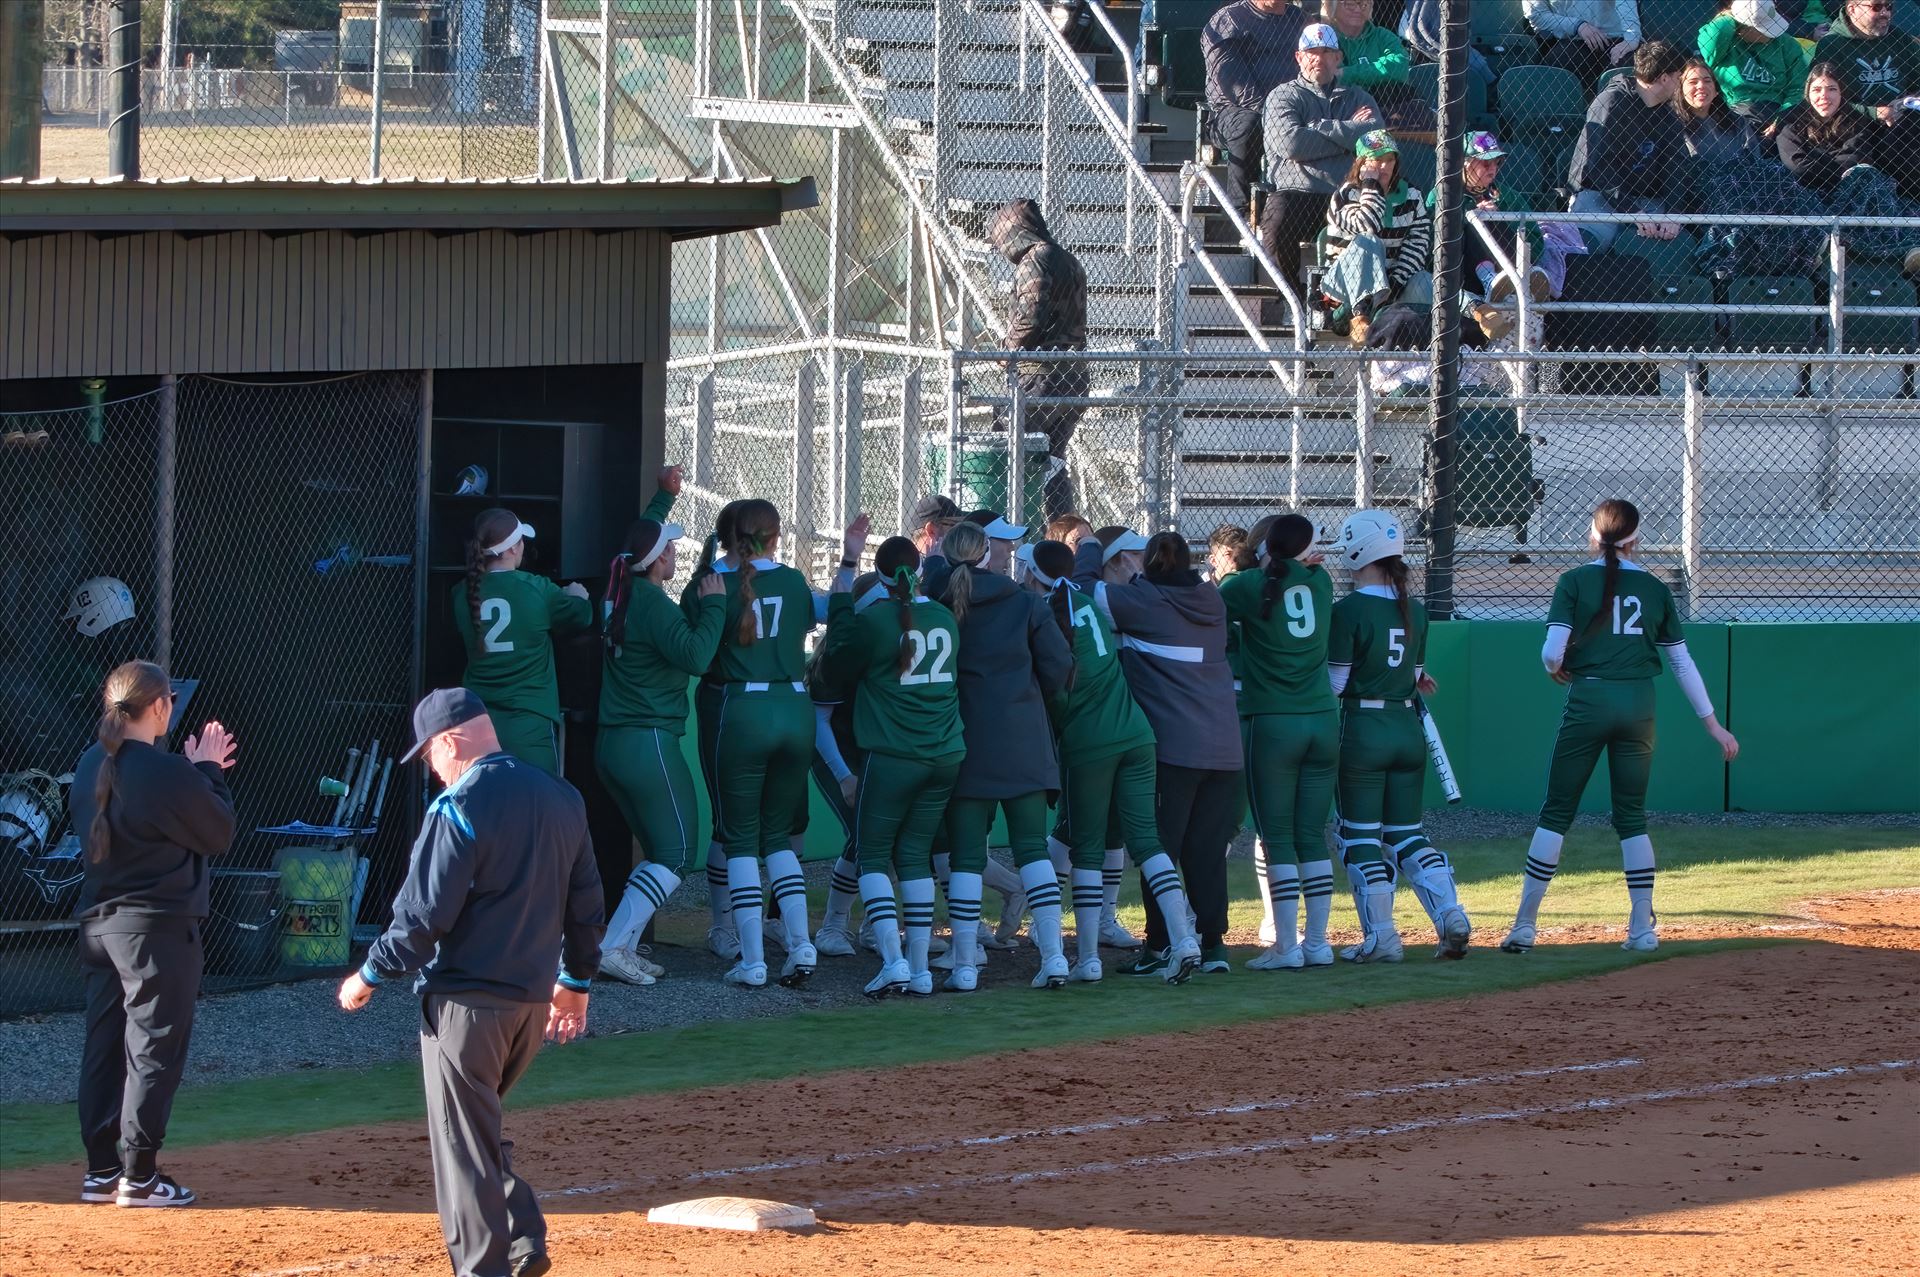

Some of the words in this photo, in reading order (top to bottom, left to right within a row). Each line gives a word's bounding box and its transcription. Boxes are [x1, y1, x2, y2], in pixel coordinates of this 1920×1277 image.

[1344, 524, 1354, 541] 5
[479, 597, 514, 653] 2
[751, 595, 783, 639] 17
[1074, 604, 1108, 657] 7
[1284, 584, 1316, 638] 9
[1612, 595, 1643, 635] 12
[899, 627, 953, 685] 22
[1387, 628, 1406, 668] 5
